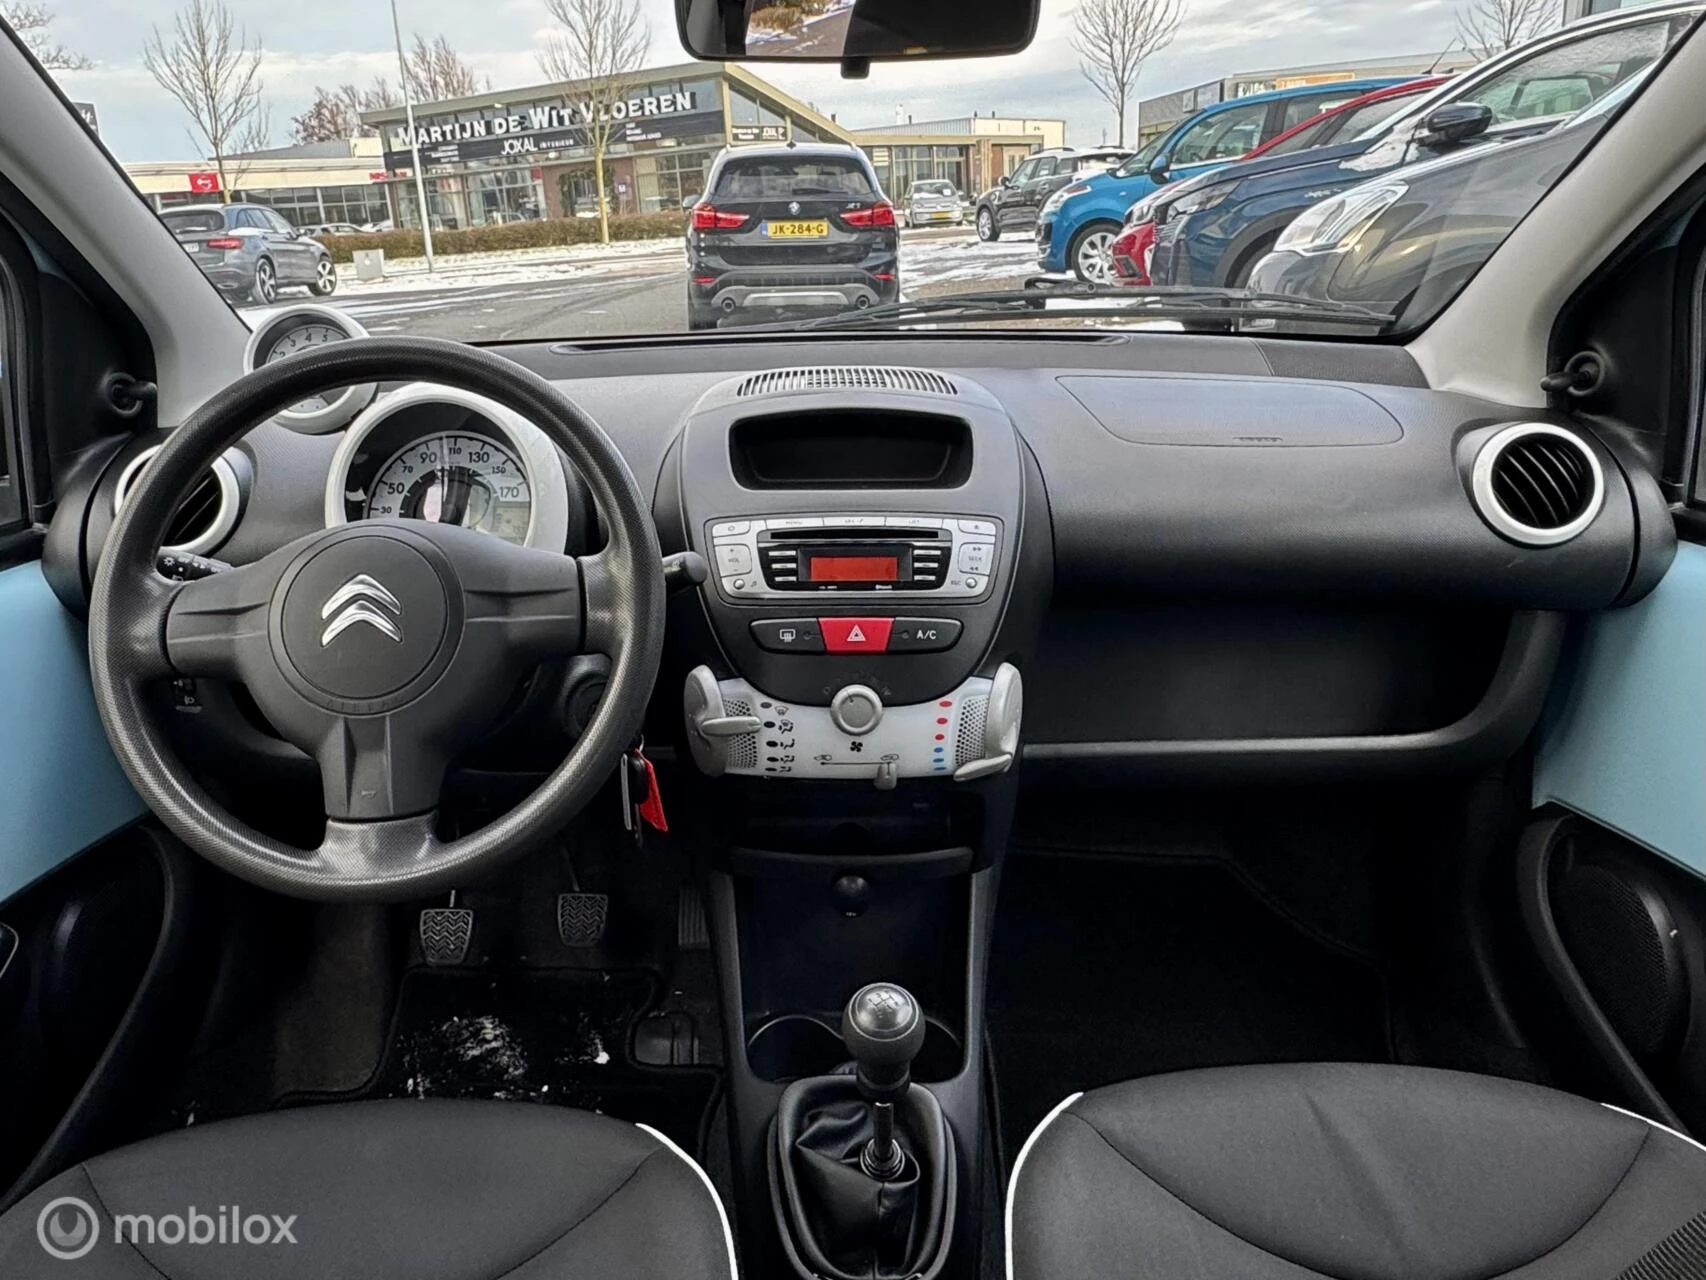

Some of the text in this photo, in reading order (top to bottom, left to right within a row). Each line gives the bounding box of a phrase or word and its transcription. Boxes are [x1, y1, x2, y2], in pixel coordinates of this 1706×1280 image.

[397, 92, 692, 146] MARTIJN DE WIT VLOEREN
[501, 137, 538, 155] JOXAL
[772, 223, 824, 235] JK-284-G
[304, 332, 312, 342] 4
[321, 334, 328, 342] 5
[289, 339, 297, 347] 3
[420, 452, 437, 464] 90
[468, 452, 490, 463] 130
[492, 466, 506, 474] 150
[387, 483, 405, 495] 50
[500, 486, 519, 498] 170
[380, 506, 392, 514] 30
[916, 629, 937, 640] A/C
